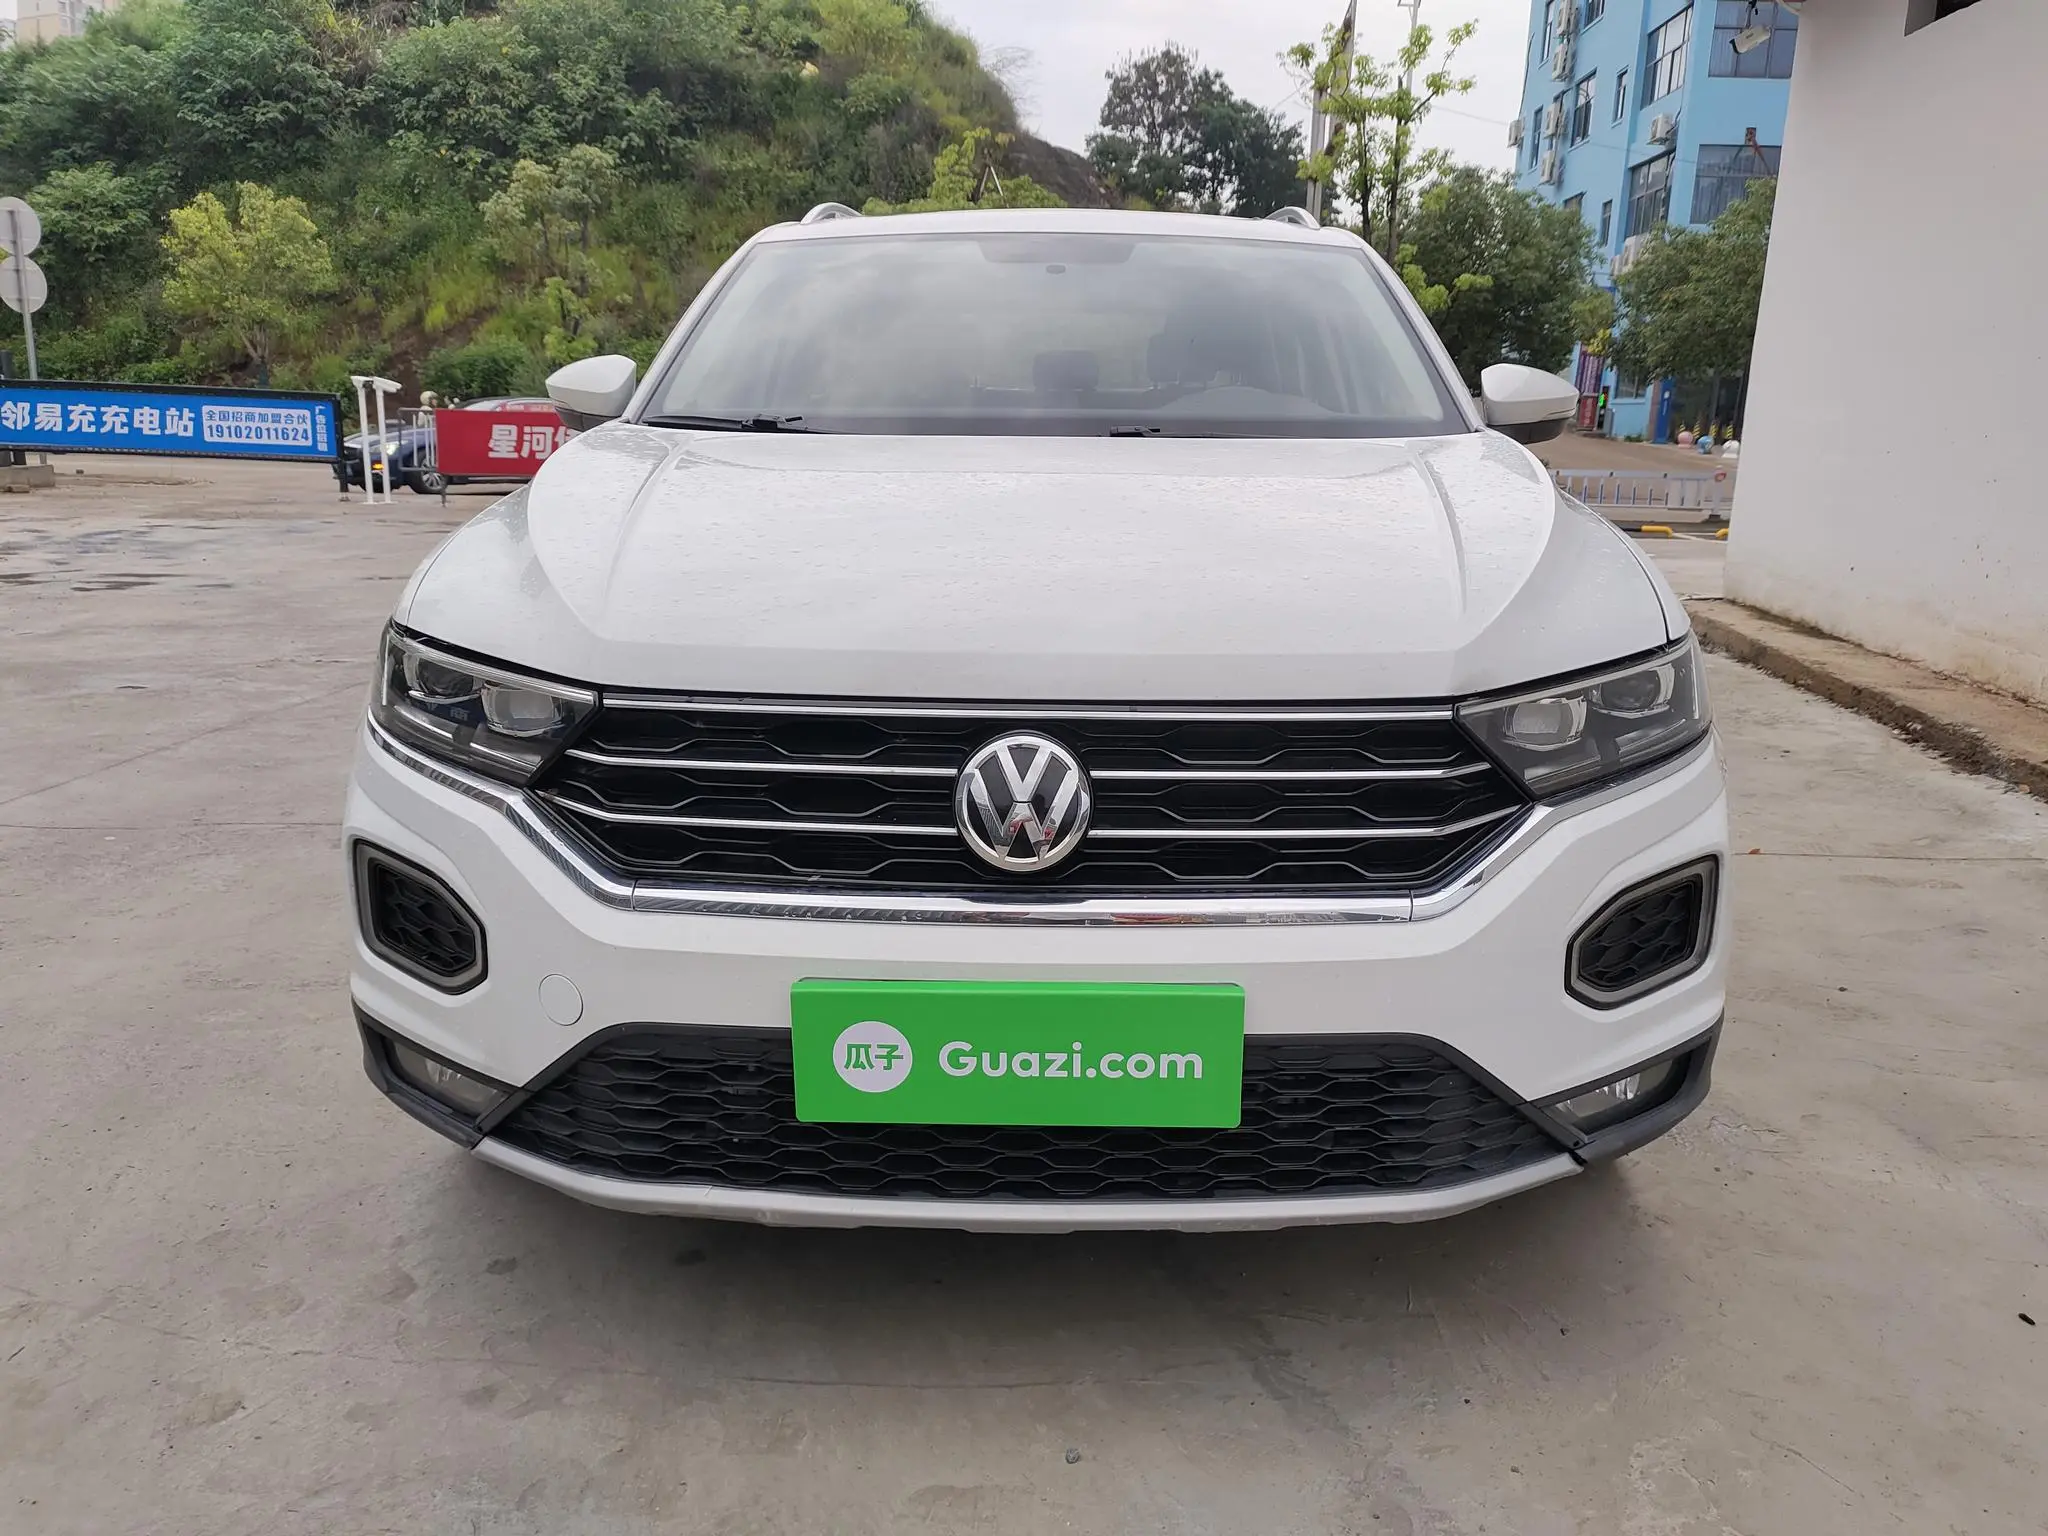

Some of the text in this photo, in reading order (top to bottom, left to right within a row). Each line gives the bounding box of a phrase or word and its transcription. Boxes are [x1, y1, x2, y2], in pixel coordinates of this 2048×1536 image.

[1, 400, 196, 437] 邻易充充电站
[206, 410, 308, 425] 全国招商加盟合伙
[207, 424, 309, 441] 19102011624
[844, 1043, 904, 1071] 瓜子
[938, 1040, 1203, 1079] Guazi.com
